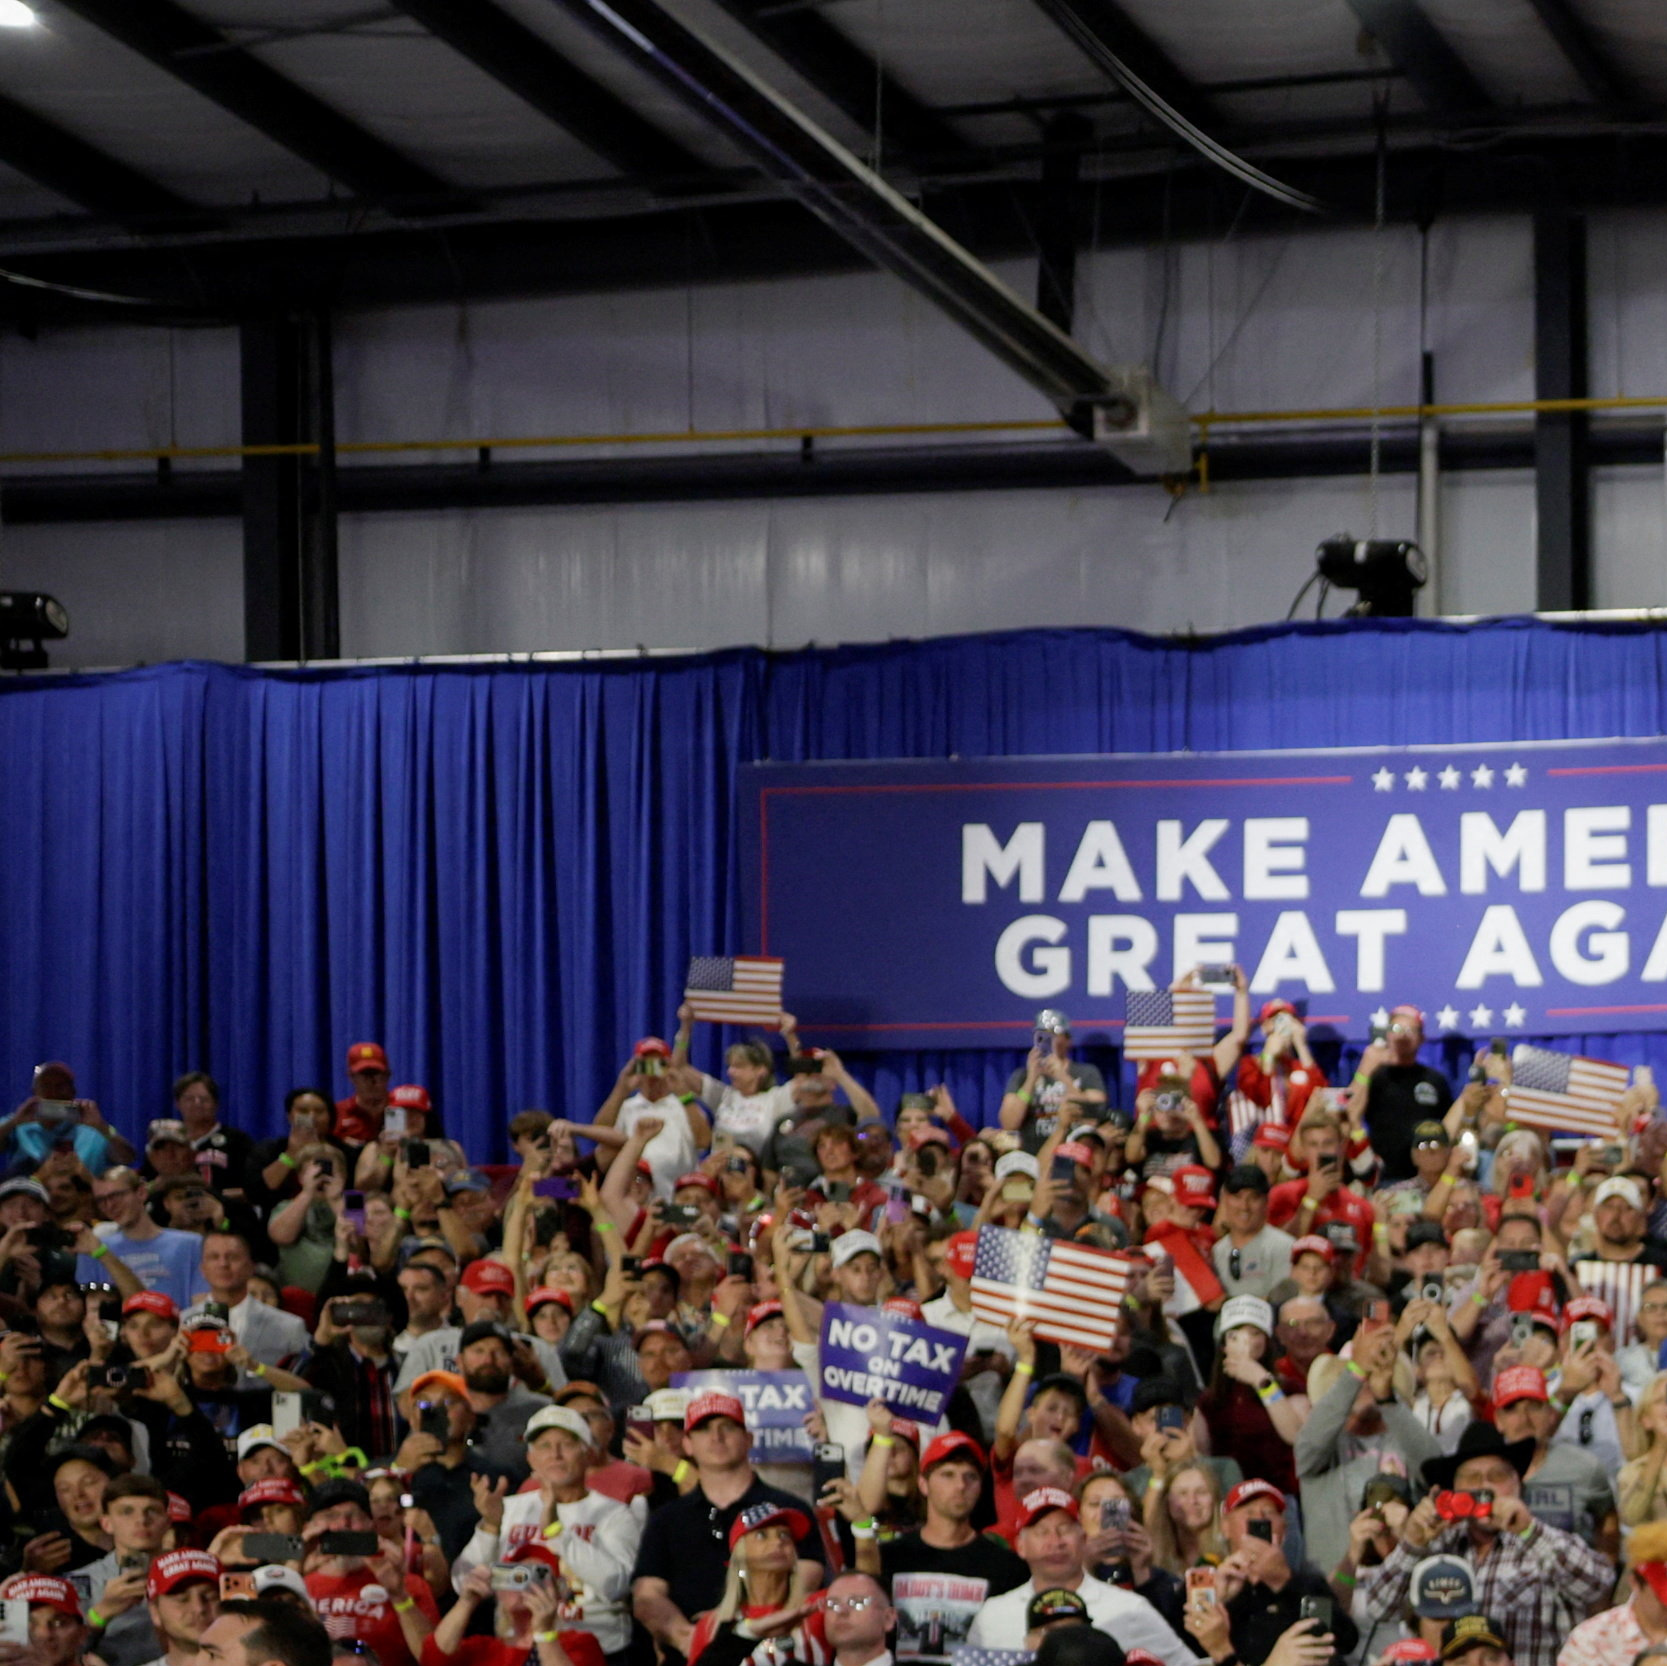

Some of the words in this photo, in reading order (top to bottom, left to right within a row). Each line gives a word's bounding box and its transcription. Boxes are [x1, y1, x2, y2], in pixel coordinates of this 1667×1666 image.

[960, 815, 1312, 905] MAKE
[994, 908, 1410, 1000] GREAT
[827, 1318, 878, 1353] NO
[887, 1330, 957, 1375] TAX
[867, 1355, 901, 1379] ON
[737, 1384, 807, 1410] TAX
[823, 1365, 944, 1414] OVERTIME
